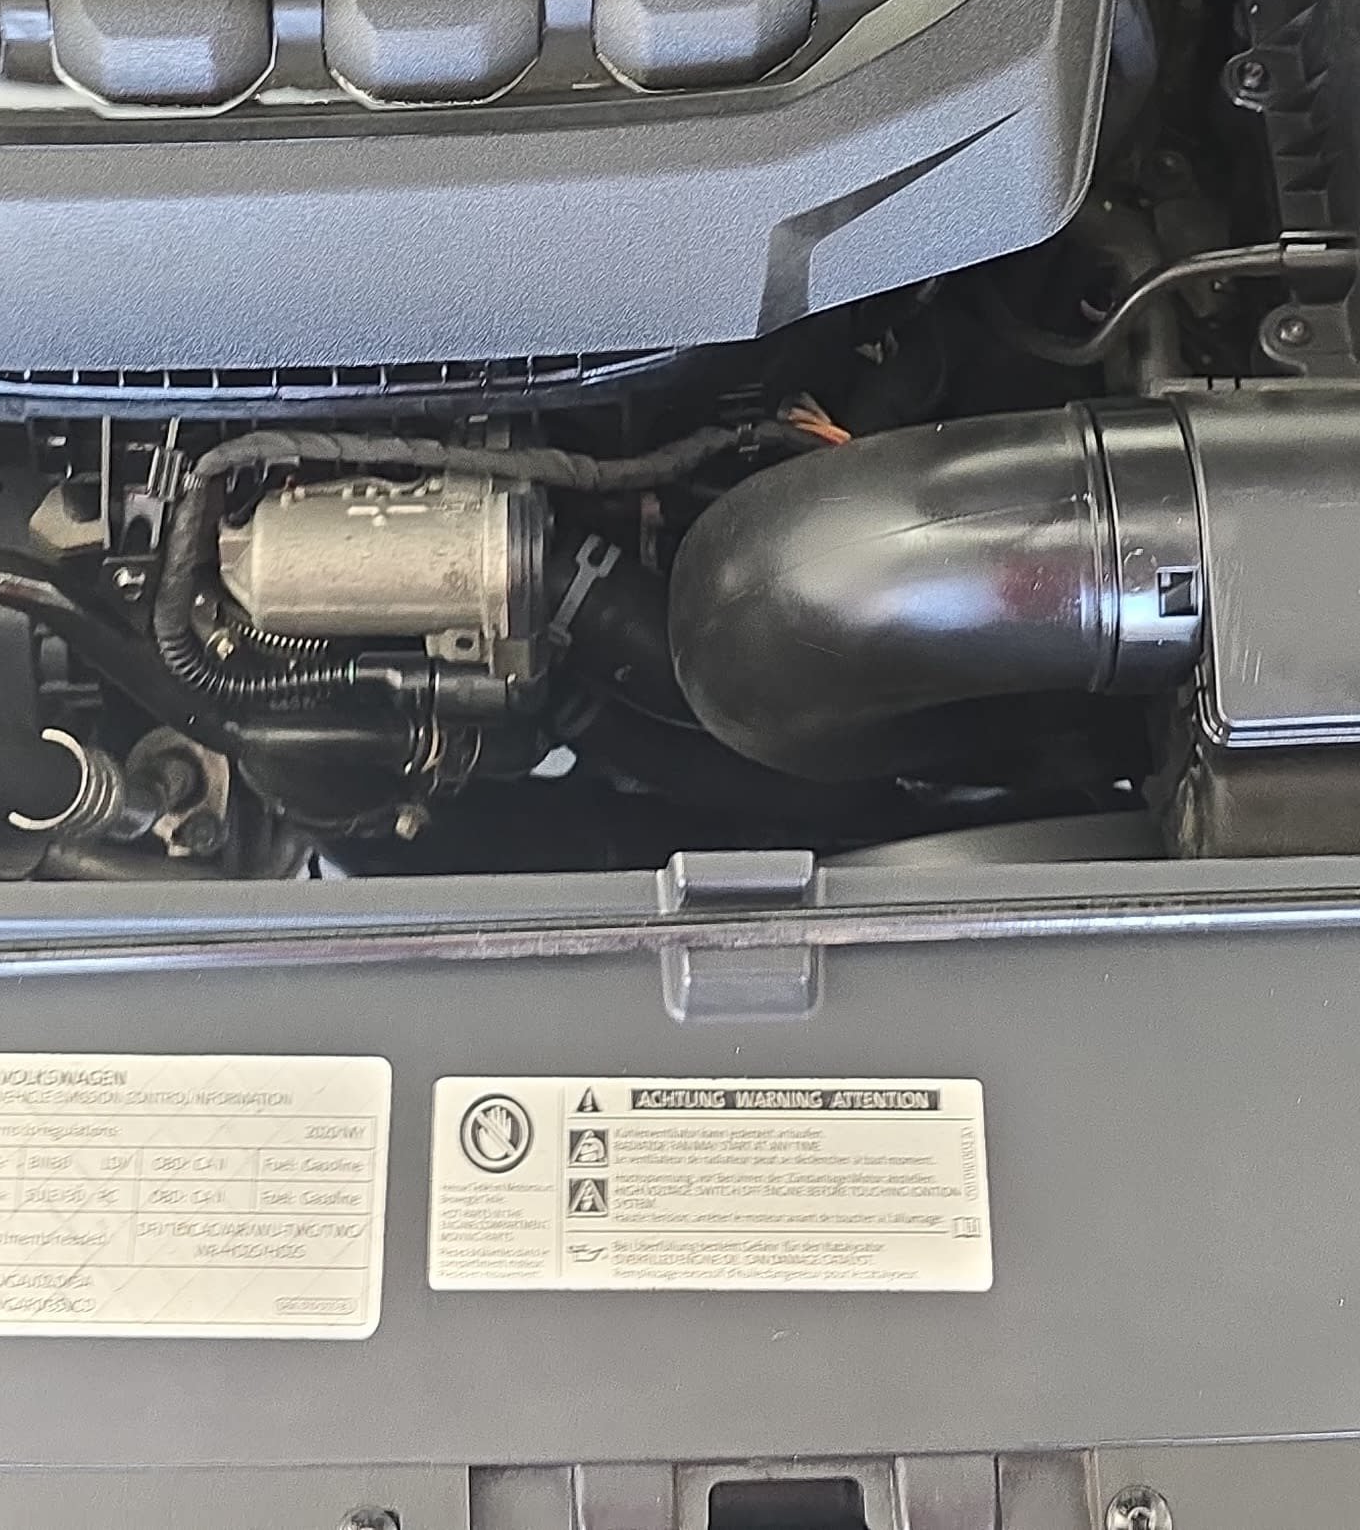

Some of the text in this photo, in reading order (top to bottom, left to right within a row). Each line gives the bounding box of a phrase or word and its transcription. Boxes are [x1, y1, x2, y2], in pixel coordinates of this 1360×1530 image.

[637, 1090, 931, 1110] ACHTUNG WARNING ATTENTION
